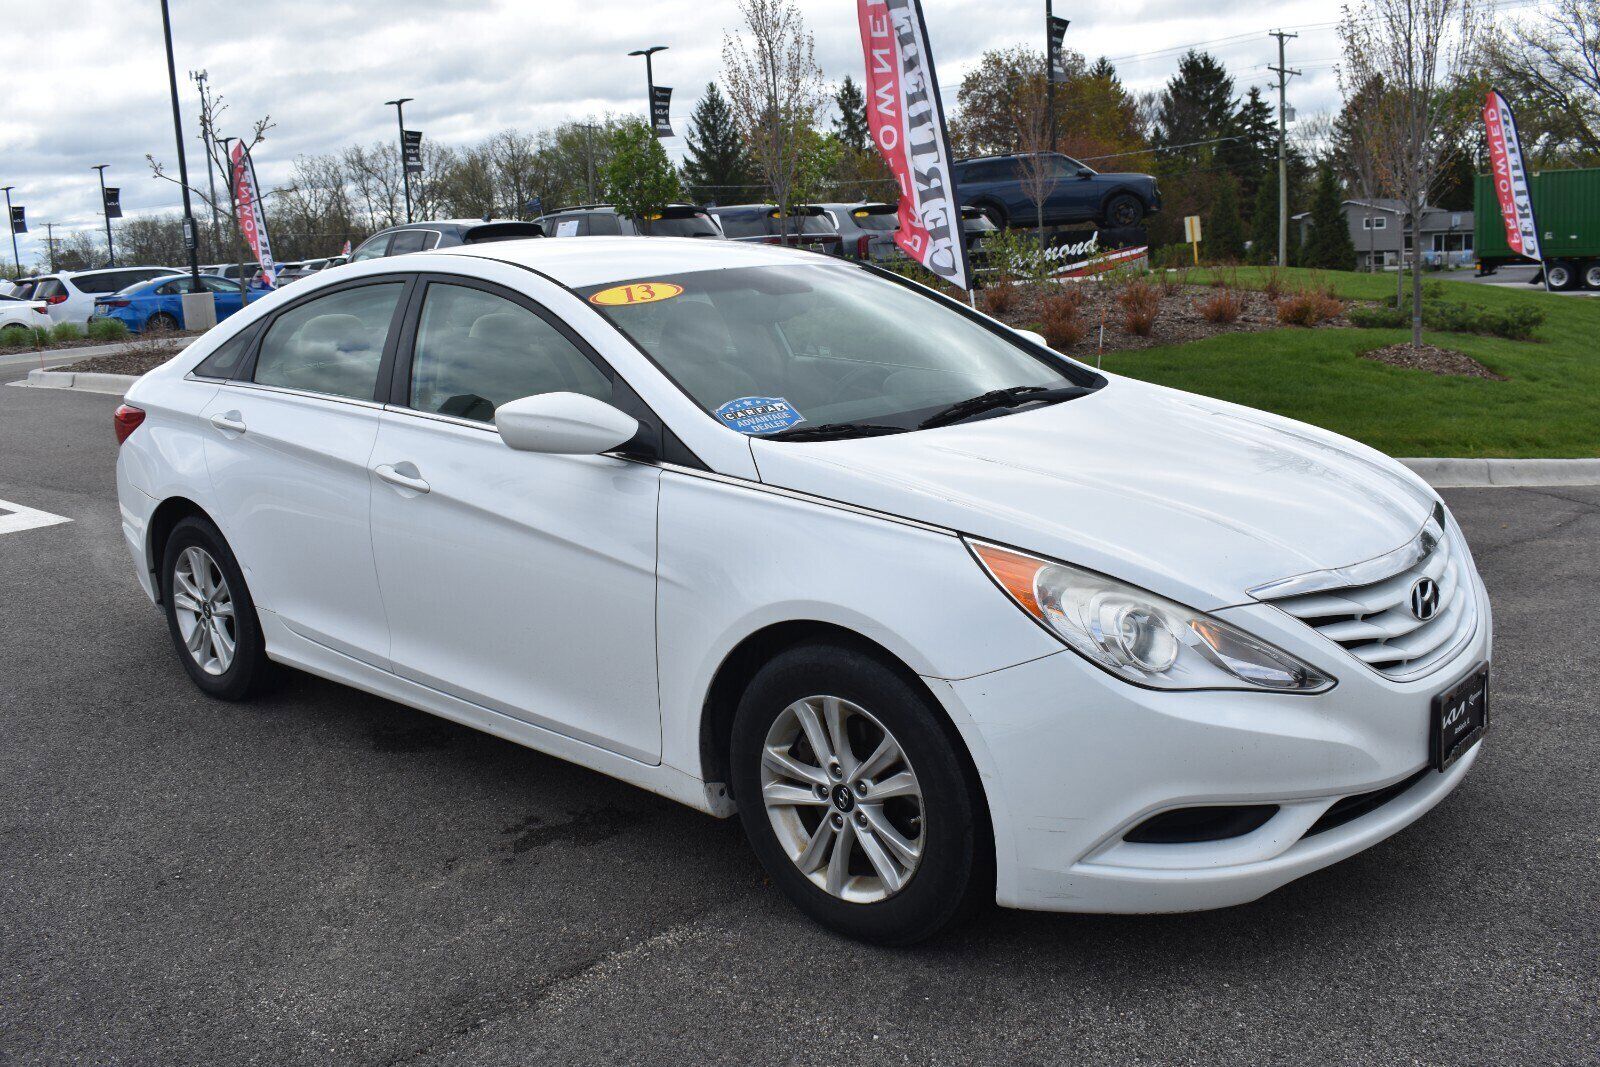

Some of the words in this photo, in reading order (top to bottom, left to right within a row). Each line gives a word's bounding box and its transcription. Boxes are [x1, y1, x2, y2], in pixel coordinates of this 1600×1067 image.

[620, 284, 656, 303] 13
[724, 402, 789, 420] CARFAX
[736, 411, 792, 428] ADVANTAGE
[751, 419, 789, 432] DEALER
